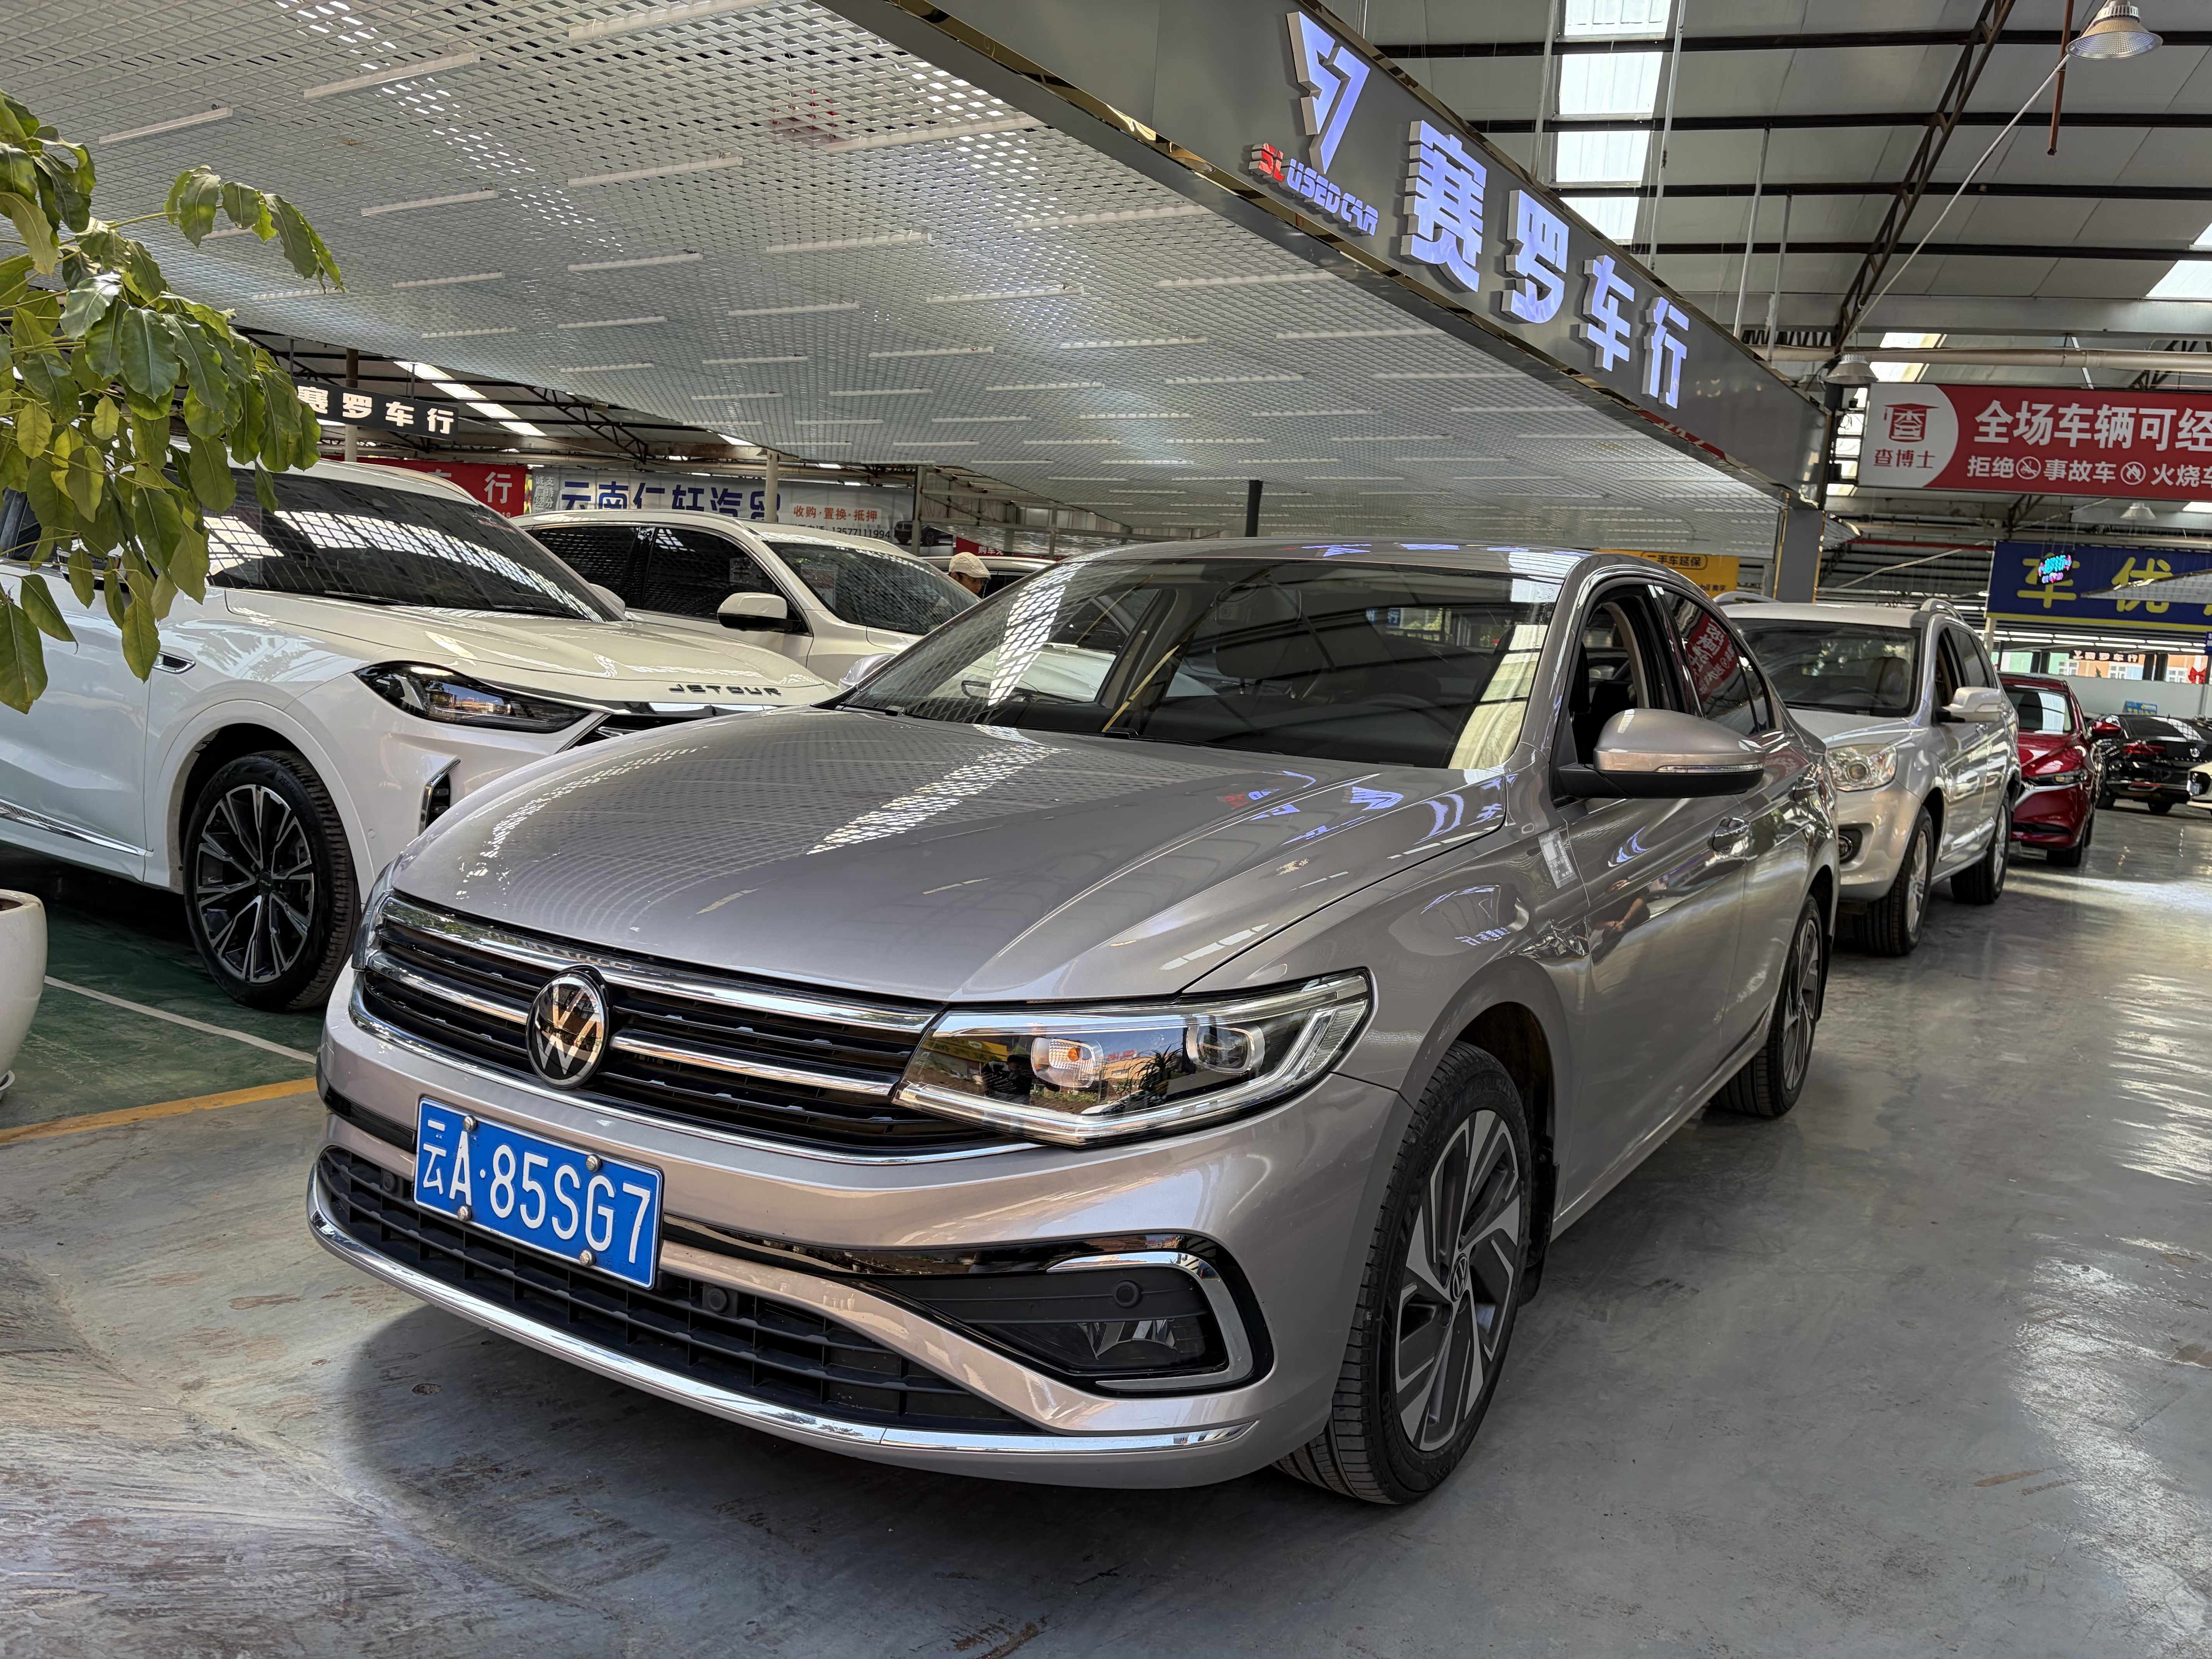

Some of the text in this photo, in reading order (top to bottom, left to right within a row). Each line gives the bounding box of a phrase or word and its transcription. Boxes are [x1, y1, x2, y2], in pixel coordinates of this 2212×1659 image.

[1410, 120, 1689, 409] 赛罗车行
[297, 385, 454, 434] 赛罗车行
[1973, 399, 2212, 454] 全场车辆可经
[1874, 448, 1936, 470] 查博士
[1966, 455, 2212, 488] 拒绝 事故车 火烧车
[535, 475, 544, 513] 诚信经
[545, 476, 555, 511] 支持分
[668, 684, 781, 696] JETOUR
